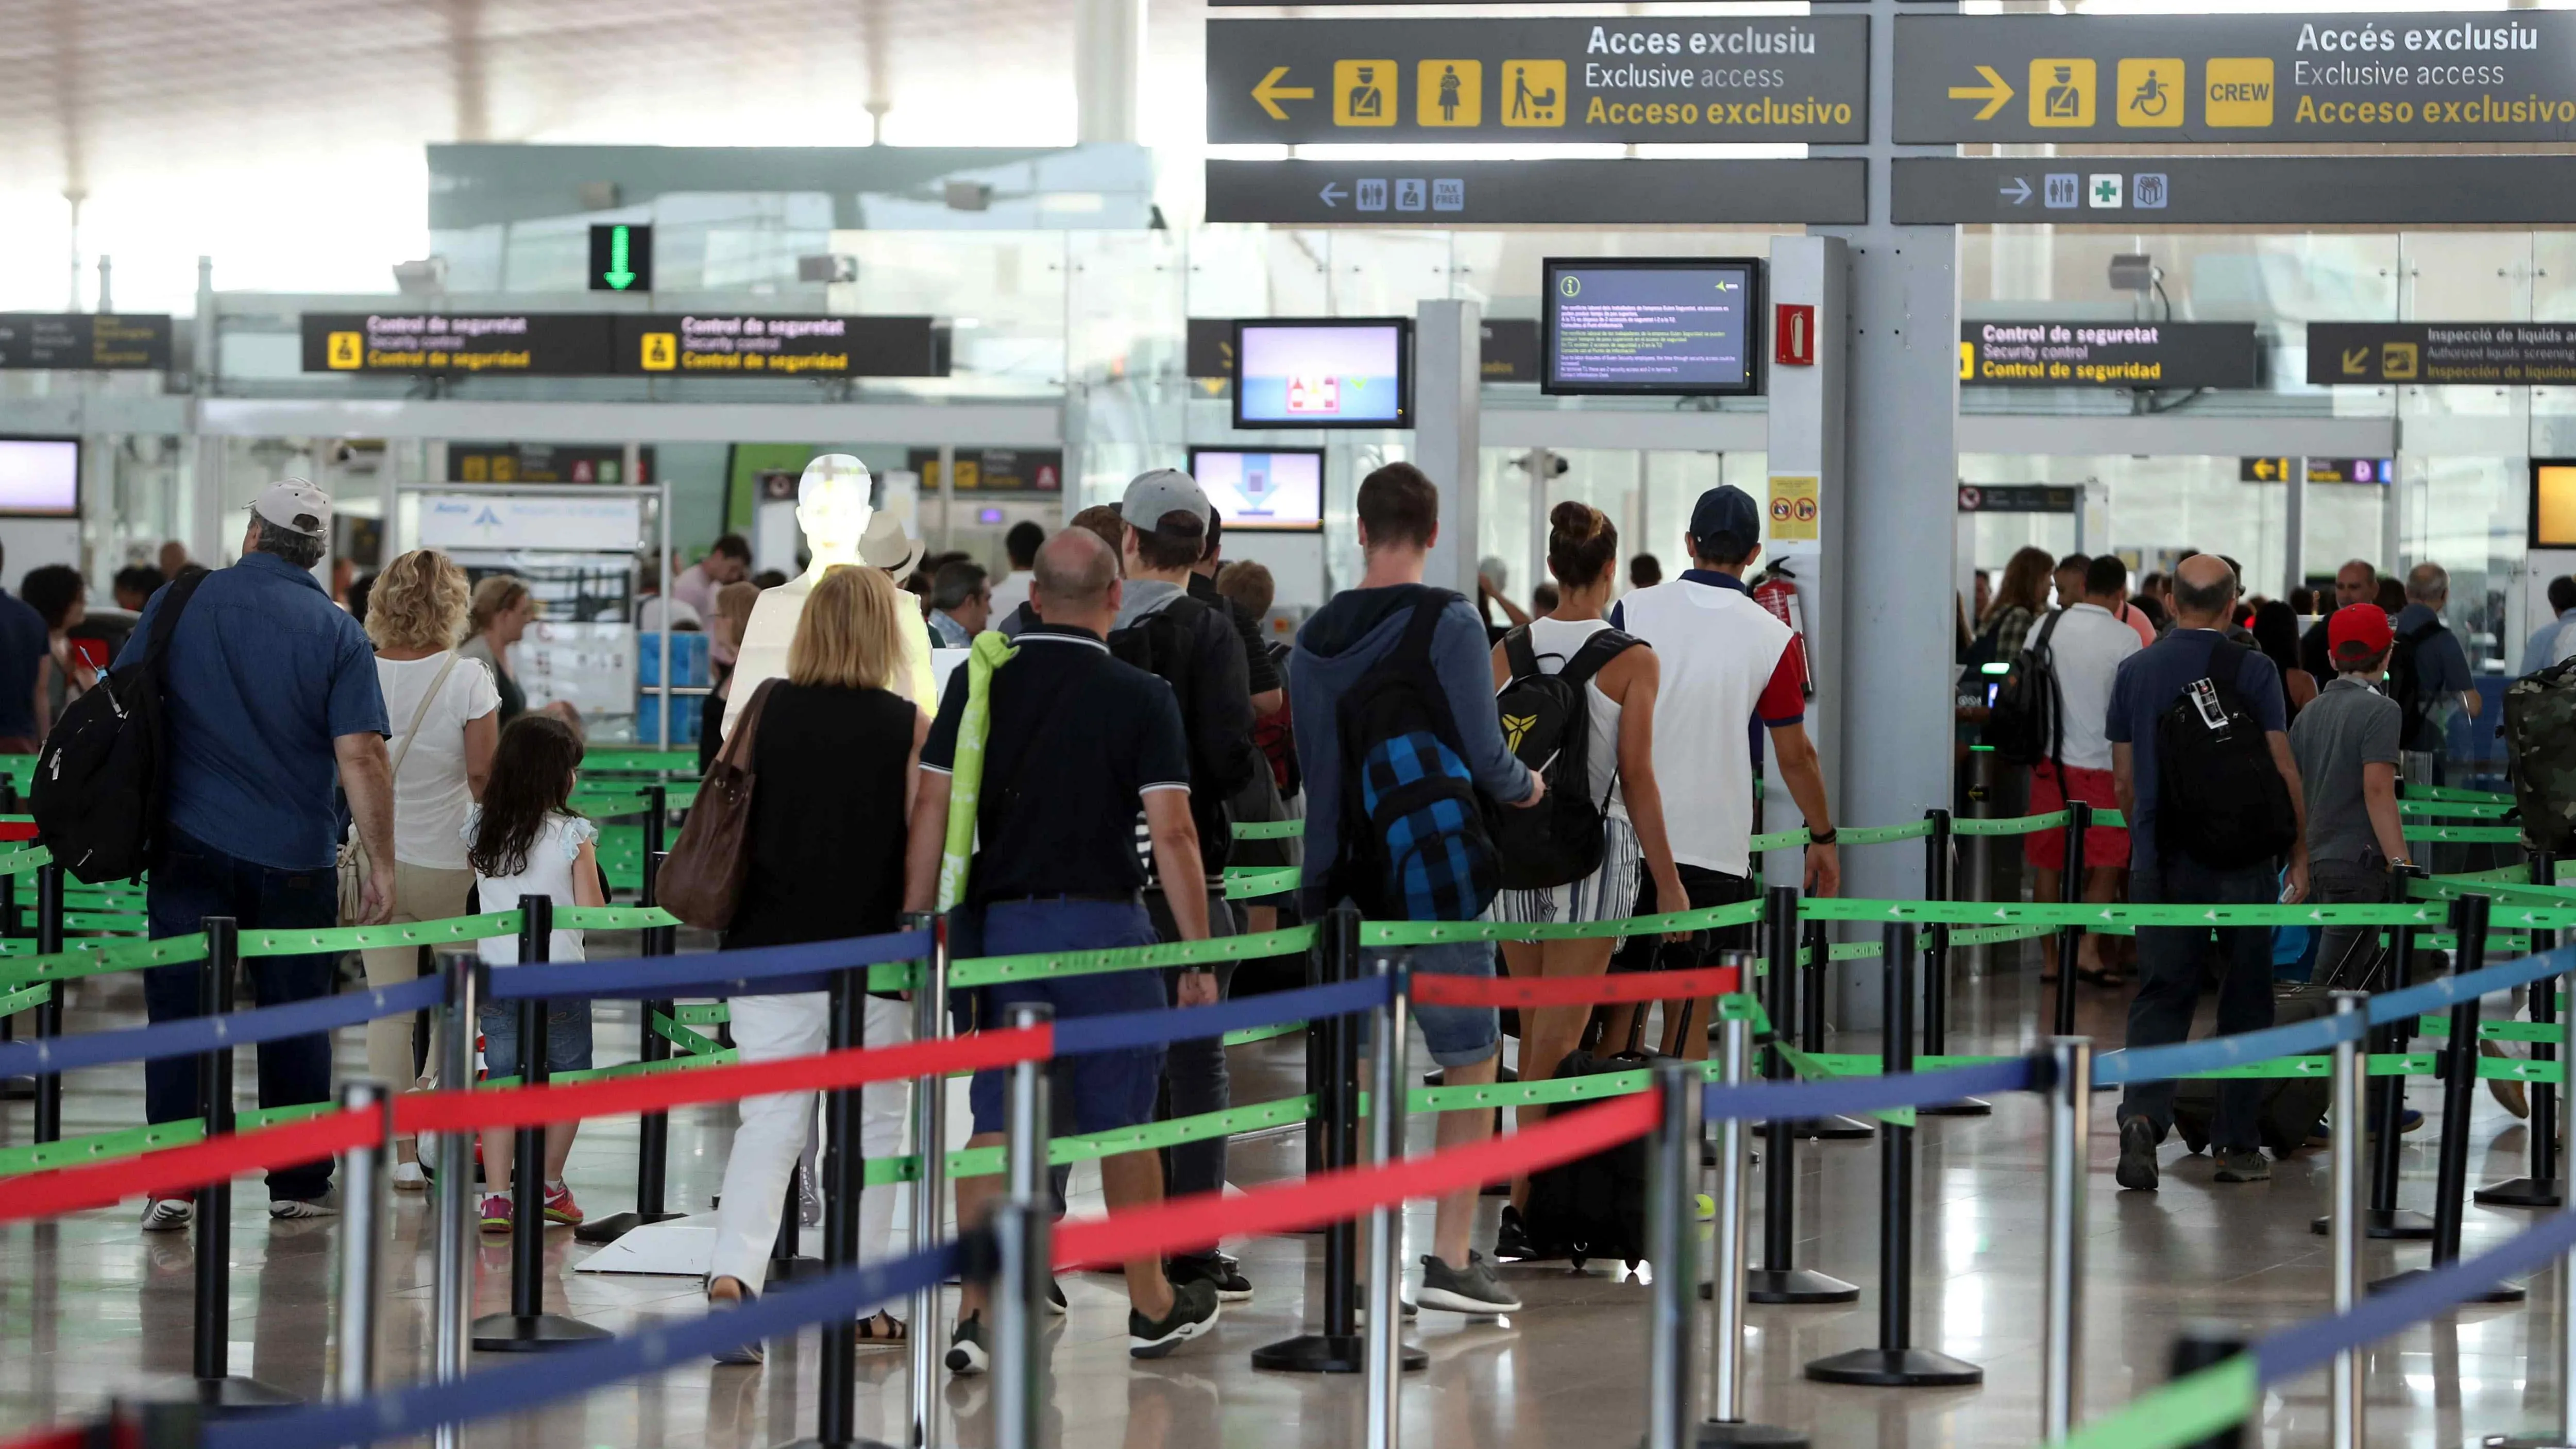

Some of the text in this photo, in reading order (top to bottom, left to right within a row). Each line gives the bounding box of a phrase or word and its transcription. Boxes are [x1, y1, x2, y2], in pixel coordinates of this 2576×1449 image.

[1587, 26, 1816, 54] Acces exclusiu
[2296, 21, 2537, 52] Accés exclusiu
[1585, 63, 1784, 88] Exclusive access
[2294, 60, 2504, 86] Exclusive access
[2210, 83, 2269, 101] CREW
[1585, 96, 1851, 124] Acceso exclusivo
[2294, 94, 2576, 124] Acceso exclusivo
[1435, 194, 1461, 204] FREE
[1438, 184, 1458, 193] TAX
[367, 315, 527, 336] Control de seguretat
[681, 316, 845, 339] Control de seguretat
[1983, 325, 2159, 346] Control de seguretat
[367, 350, 530, 370] Control de seguridad
[682, 351, 848, 373] Control de seguridad
[1983, 344, 2088, 360] Security control
[1982, 361, 2161, 382] Control de seguridad
[2354, 460, 2371, 482] D
